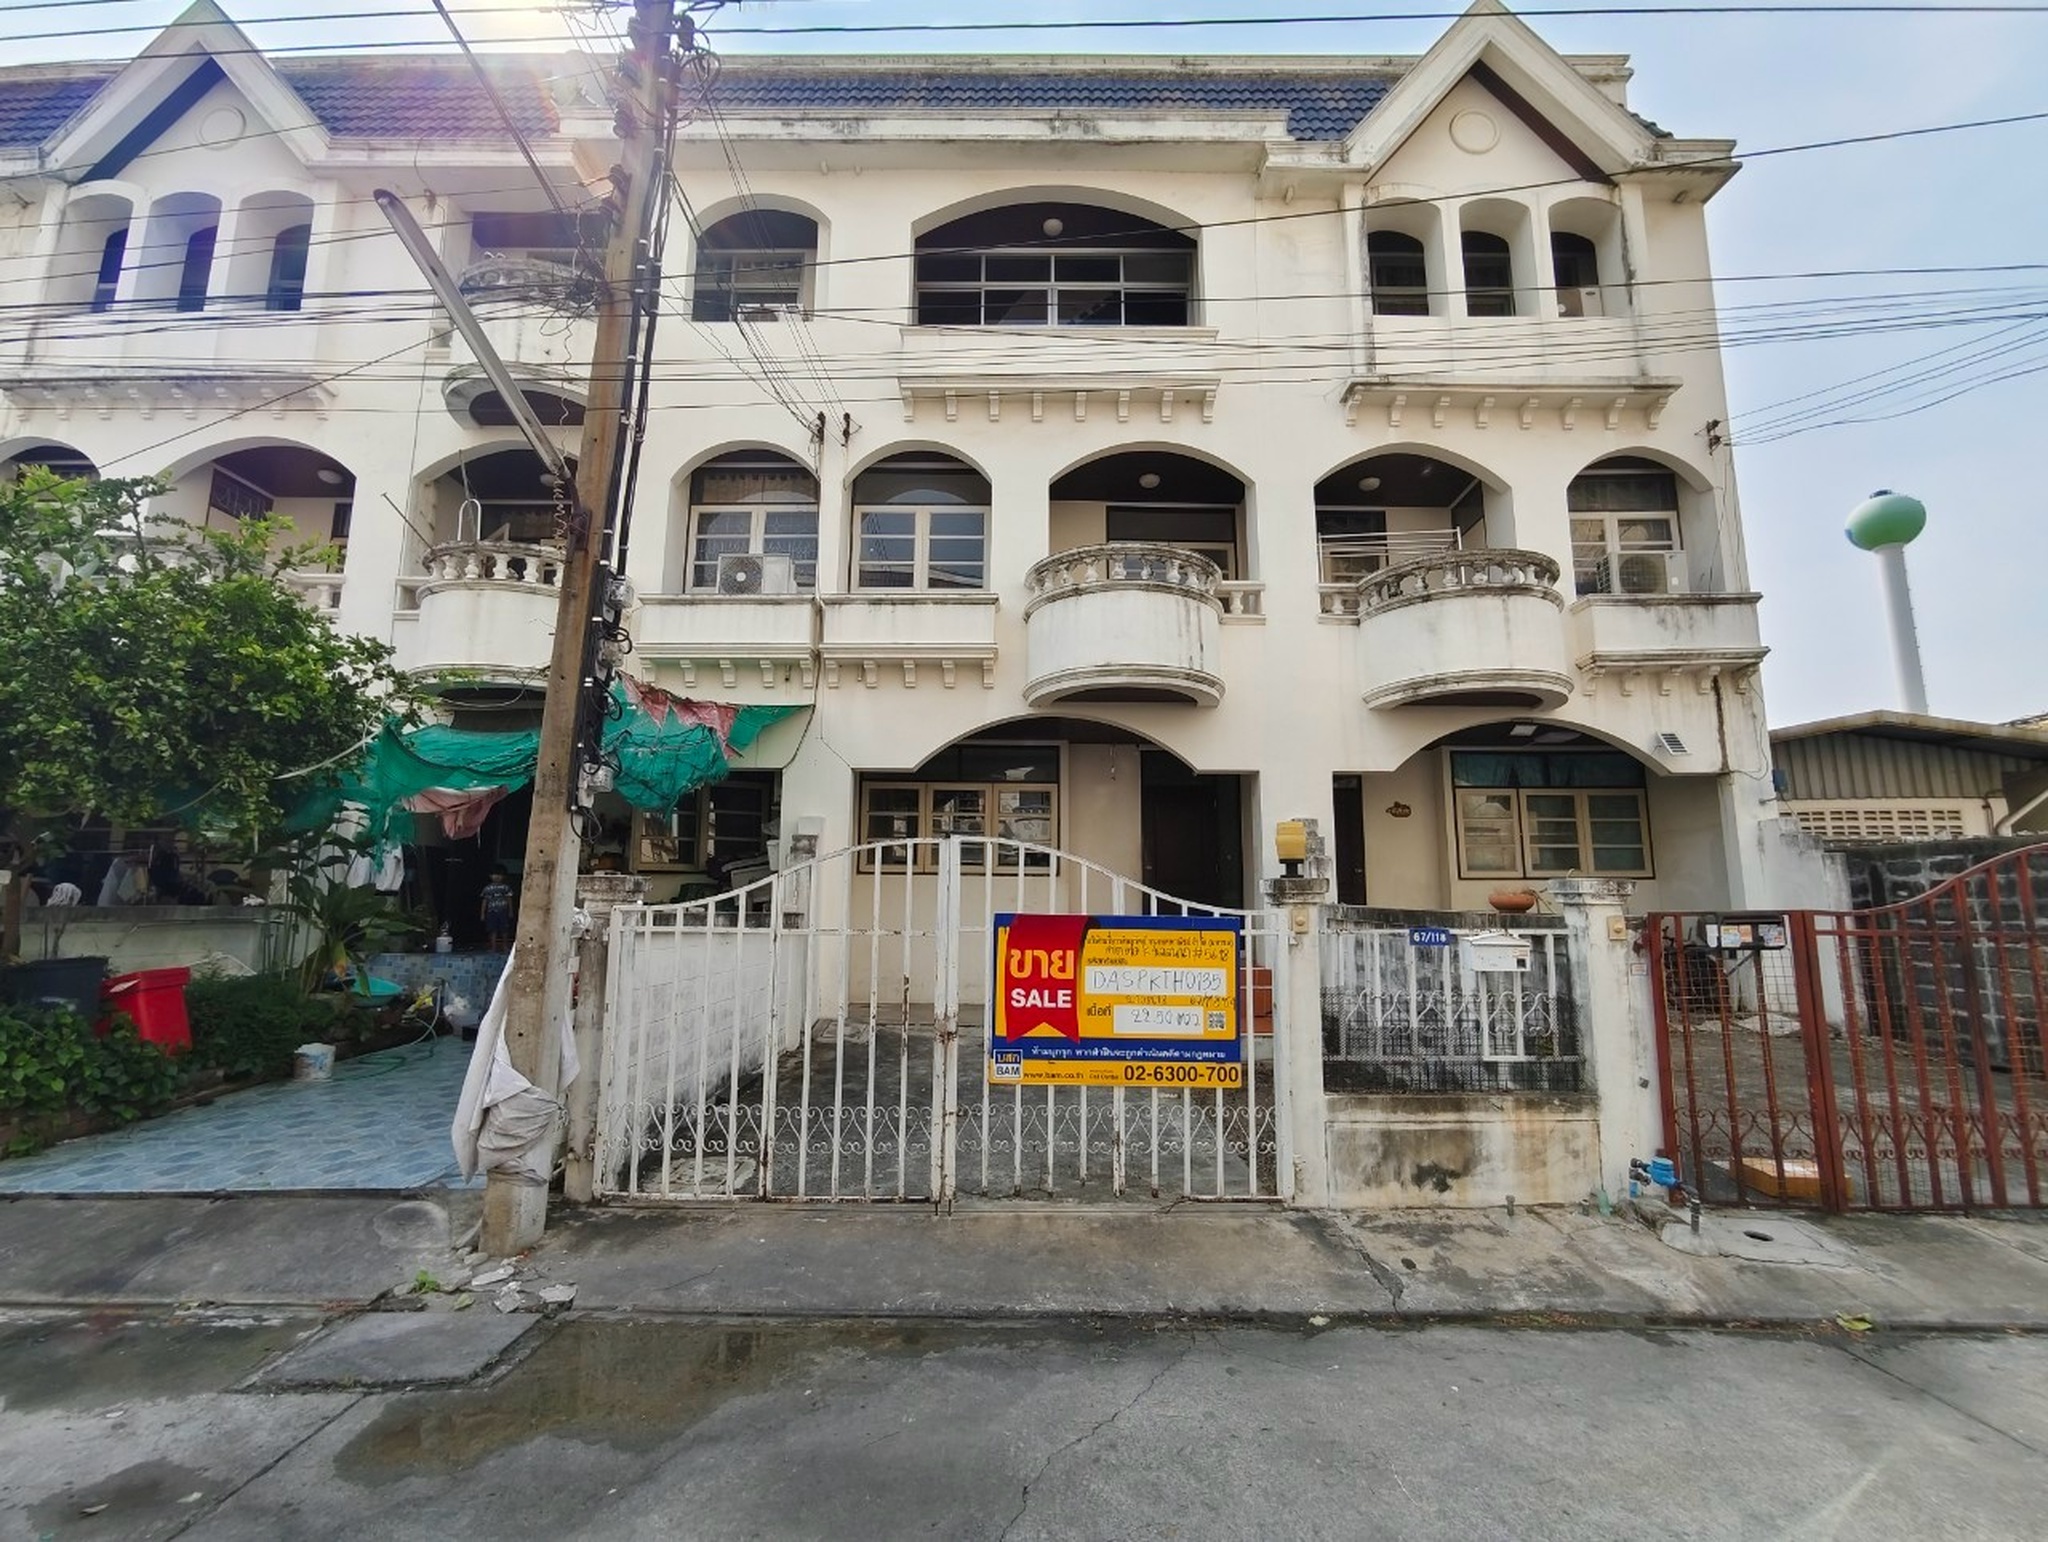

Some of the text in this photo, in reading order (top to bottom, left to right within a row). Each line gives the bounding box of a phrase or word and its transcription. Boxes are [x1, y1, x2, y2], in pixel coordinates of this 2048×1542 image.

[1010, 949, 1075, 979] ขาย
[1011, 988, 1072, 1008] SALE
[996, 1066, 1020, 1076] BAM
[1024, 1071, 1084, 1080] www.bam.co.th
[1124, 1065, 1239, 1083] 02-6300-700
